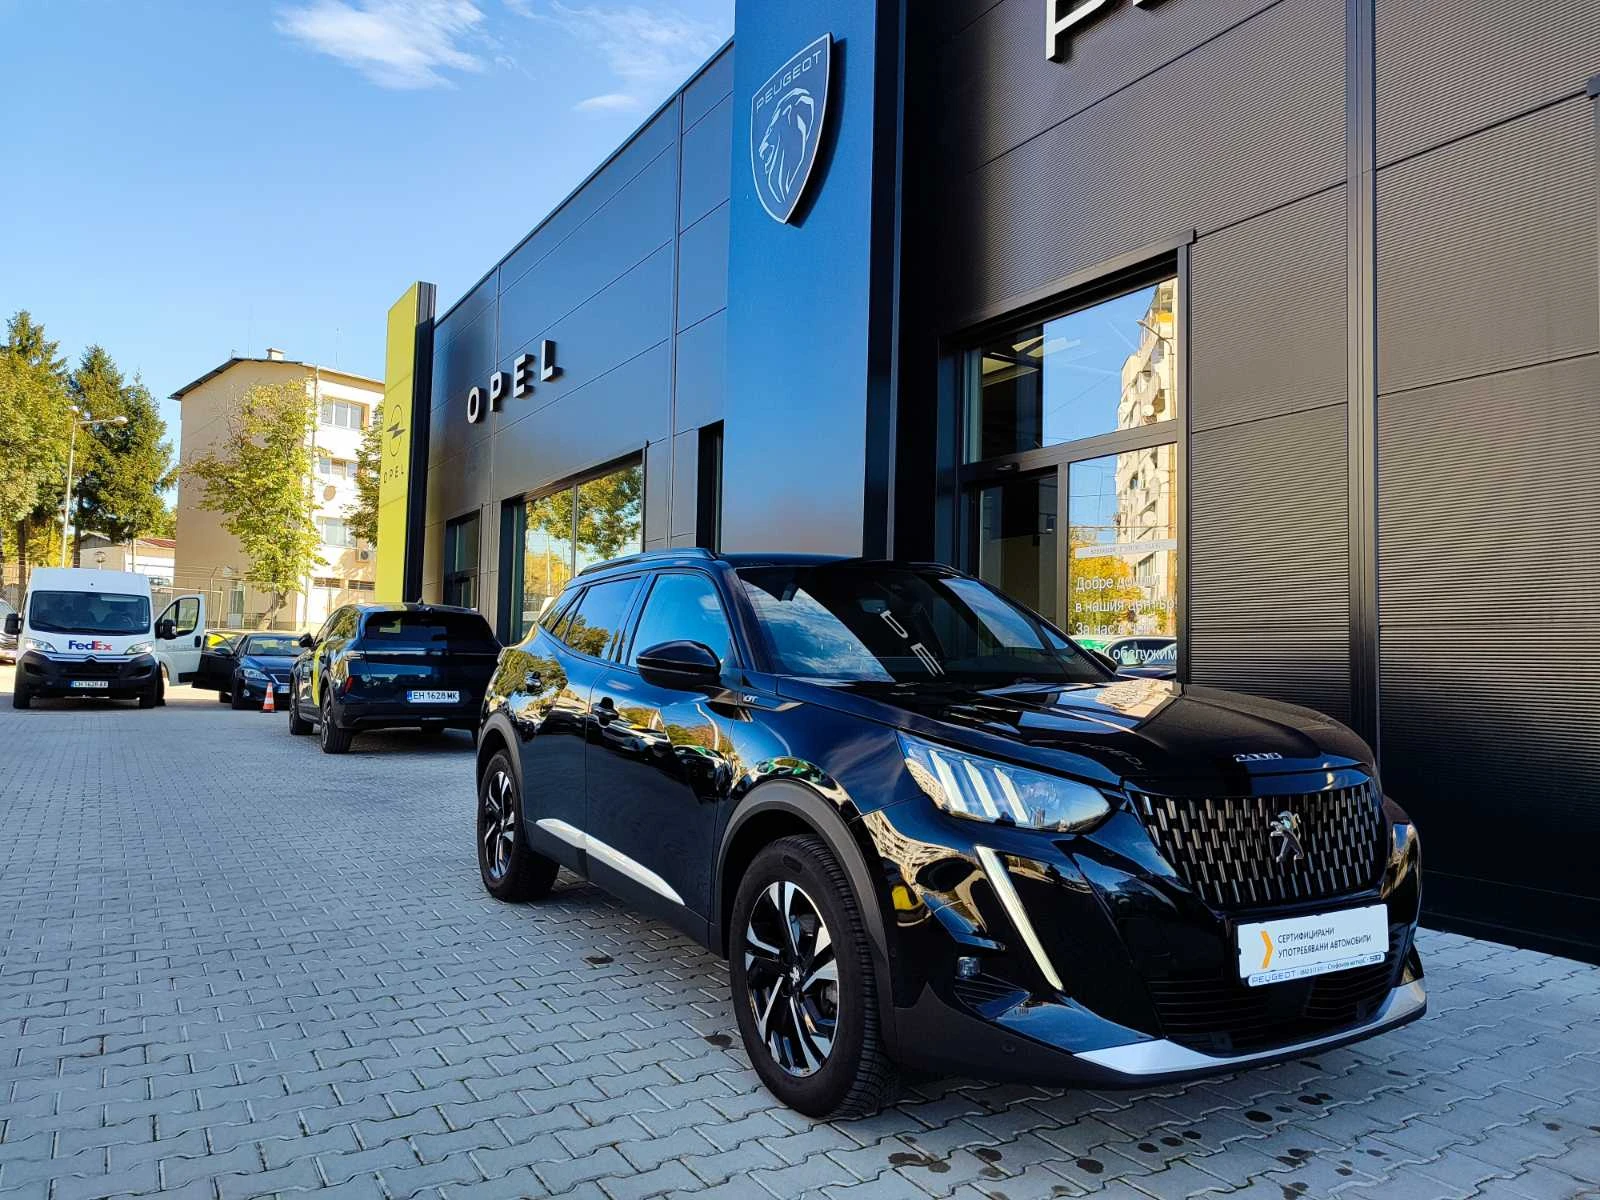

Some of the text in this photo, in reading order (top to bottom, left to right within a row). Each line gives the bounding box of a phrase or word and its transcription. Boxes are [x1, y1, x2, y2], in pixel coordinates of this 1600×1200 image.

[756, 50, 822, 113] PEUGEOT
[467, 339, 556, 424] OPEL
[383, 464, 404, 484] OPEL
[1075, 577, 1114, 592] Добре
[69, 639, 112, 650] FedEx
[1277, 927, 1336, 944] СЕРТИФИЦИРАНИ
[1329, 934, 1372, 950] АВТОМОБИЛИ
[1250, 970, 1297, 985] PEUGEOT
